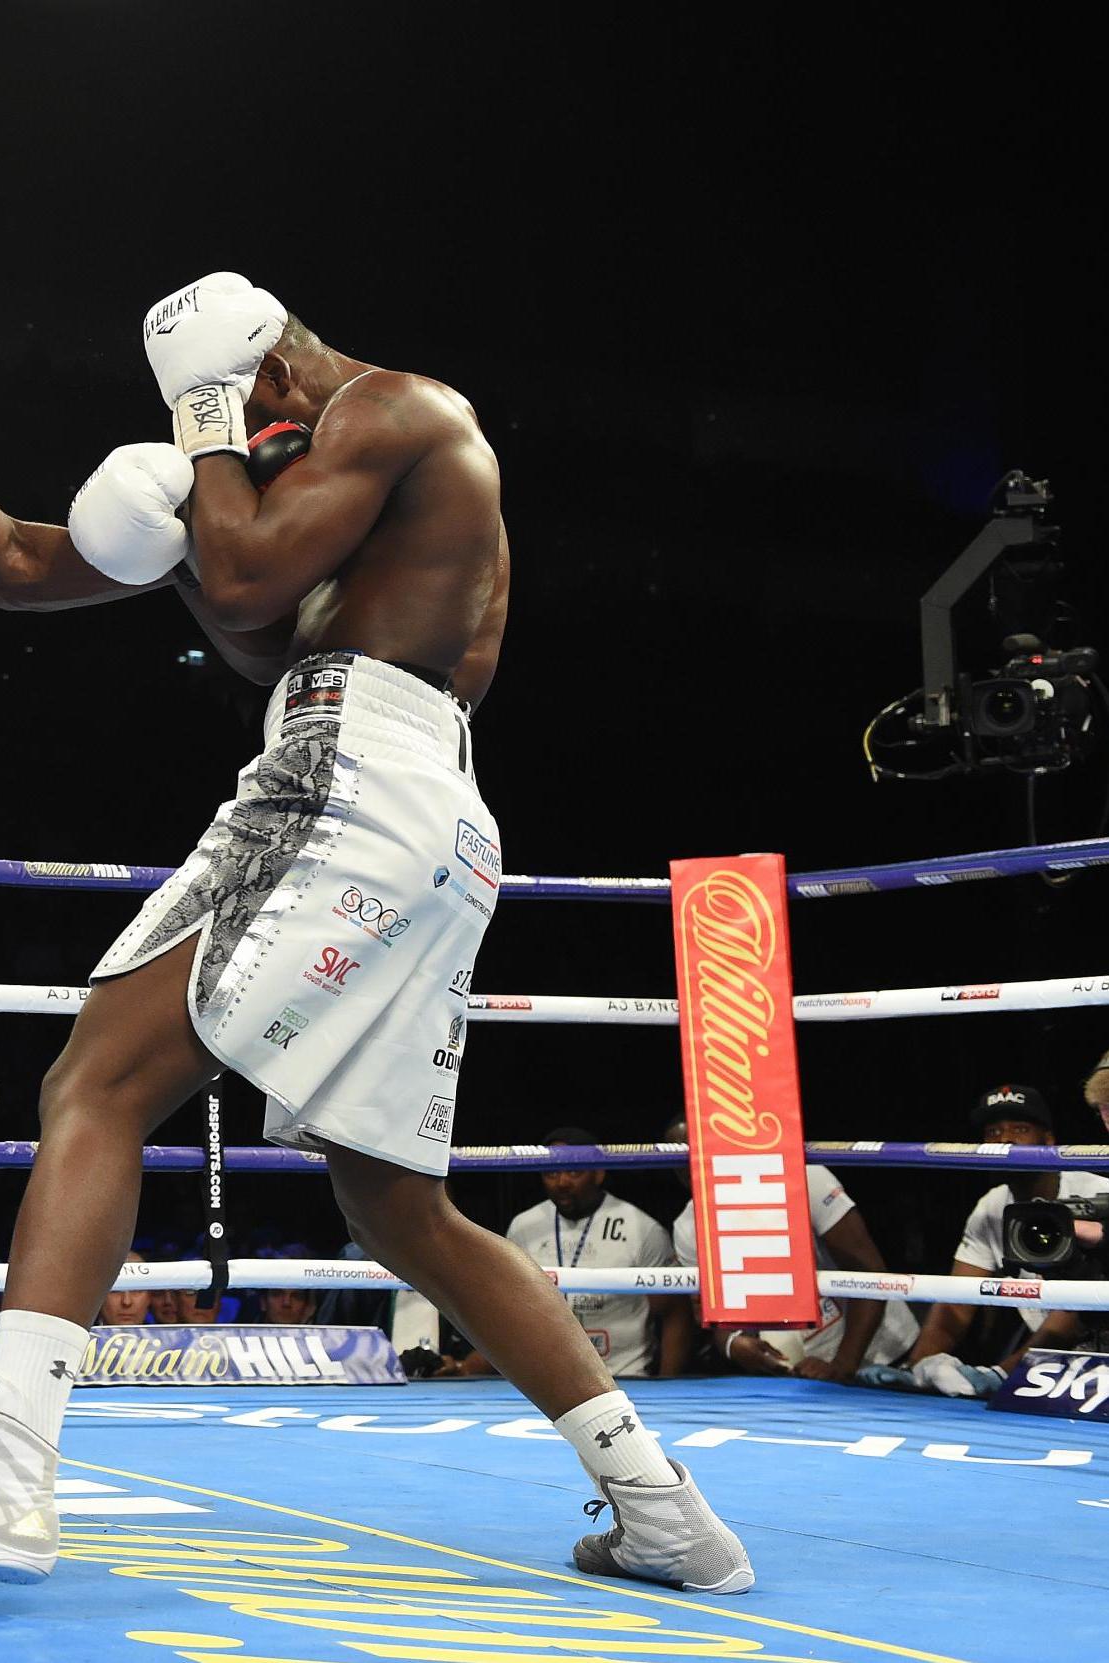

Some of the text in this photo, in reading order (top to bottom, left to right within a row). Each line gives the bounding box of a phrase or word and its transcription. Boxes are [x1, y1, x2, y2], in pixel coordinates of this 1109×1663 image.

[460, 830, 500, 872] FASTLINE
[92, 863, 131, 878] HILL
[47, 988, 70, 1000] AJ
[262, 1020, 300, 1050] BOX
[679, 870, 794, 1310] William HILL
[208, 1094, 221, 1209] JDSPORTS.COM
[603, 1217, 628, 1242] IC.
[635, 1274, 696, 1287] AJ BXN
[830, 1277, 909, 1295] matchroomboxing
[980, 1281, 1040, 1297] sky sports
[226, 1336, 347, 1378] HILL
